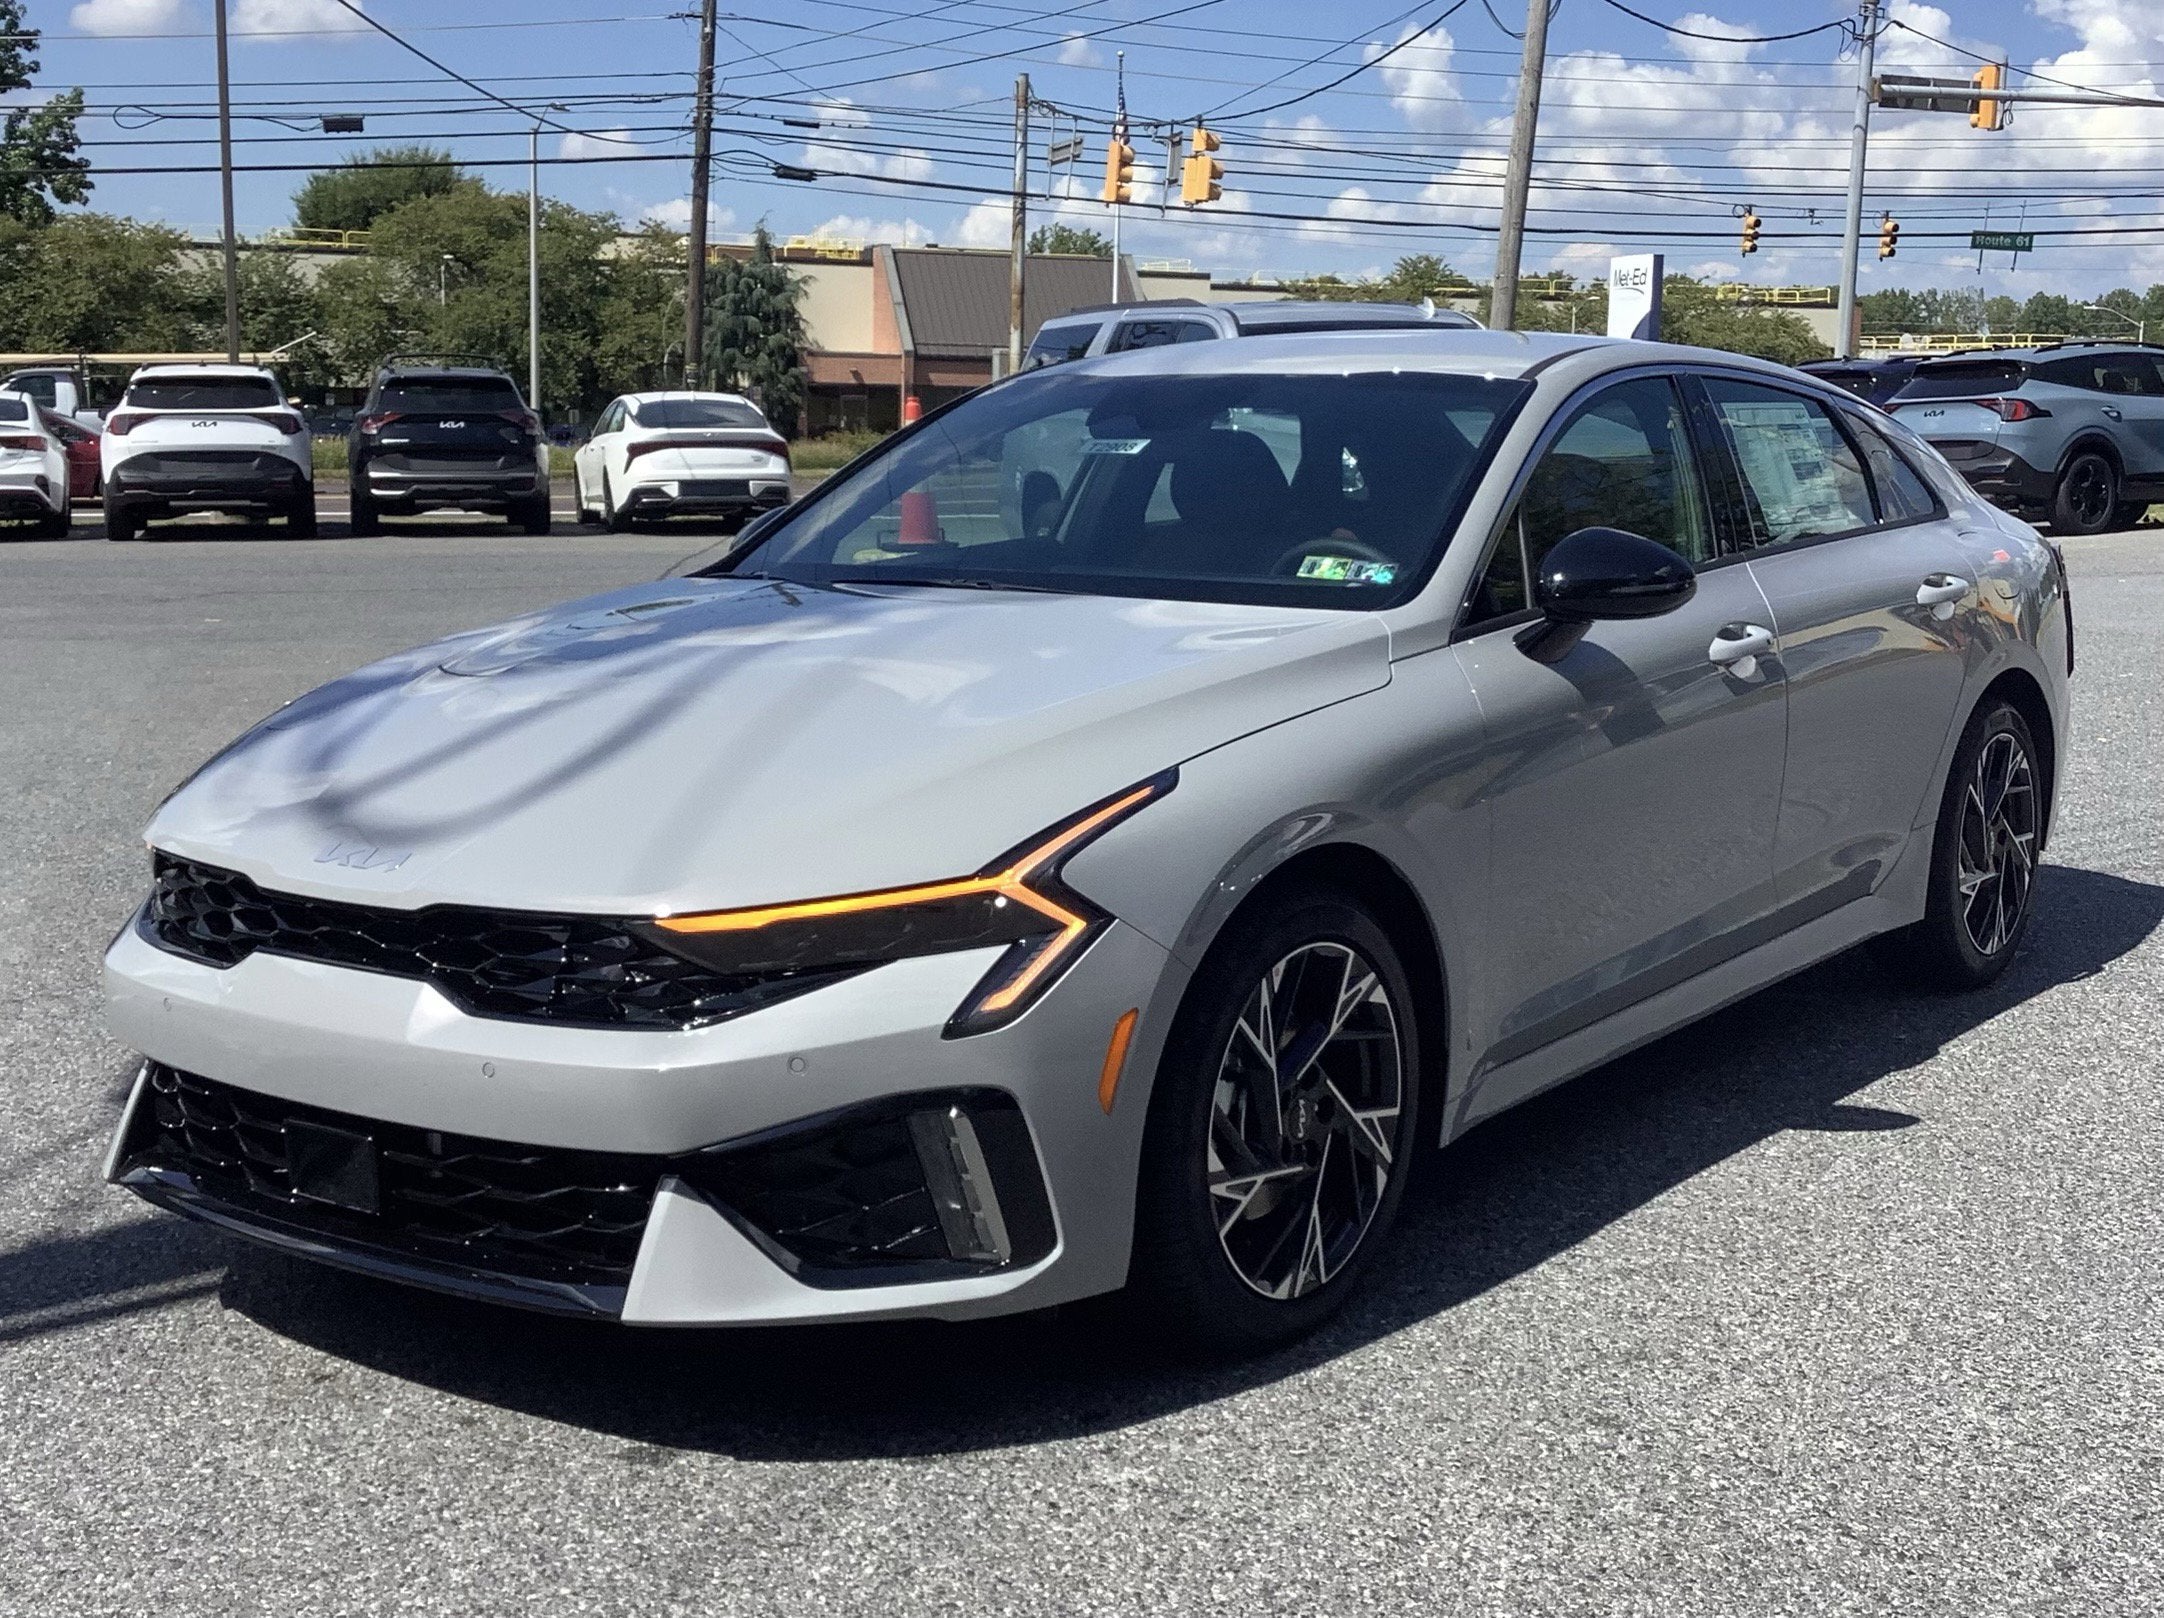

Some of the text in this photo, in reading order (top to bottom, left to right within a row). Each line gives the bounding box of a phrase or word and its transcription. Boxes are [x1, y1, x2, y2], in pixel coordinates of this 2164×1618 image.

[1975, 235, 2030, 247] Route 61
[1613, 267, 1648, 287] Met-Ed
